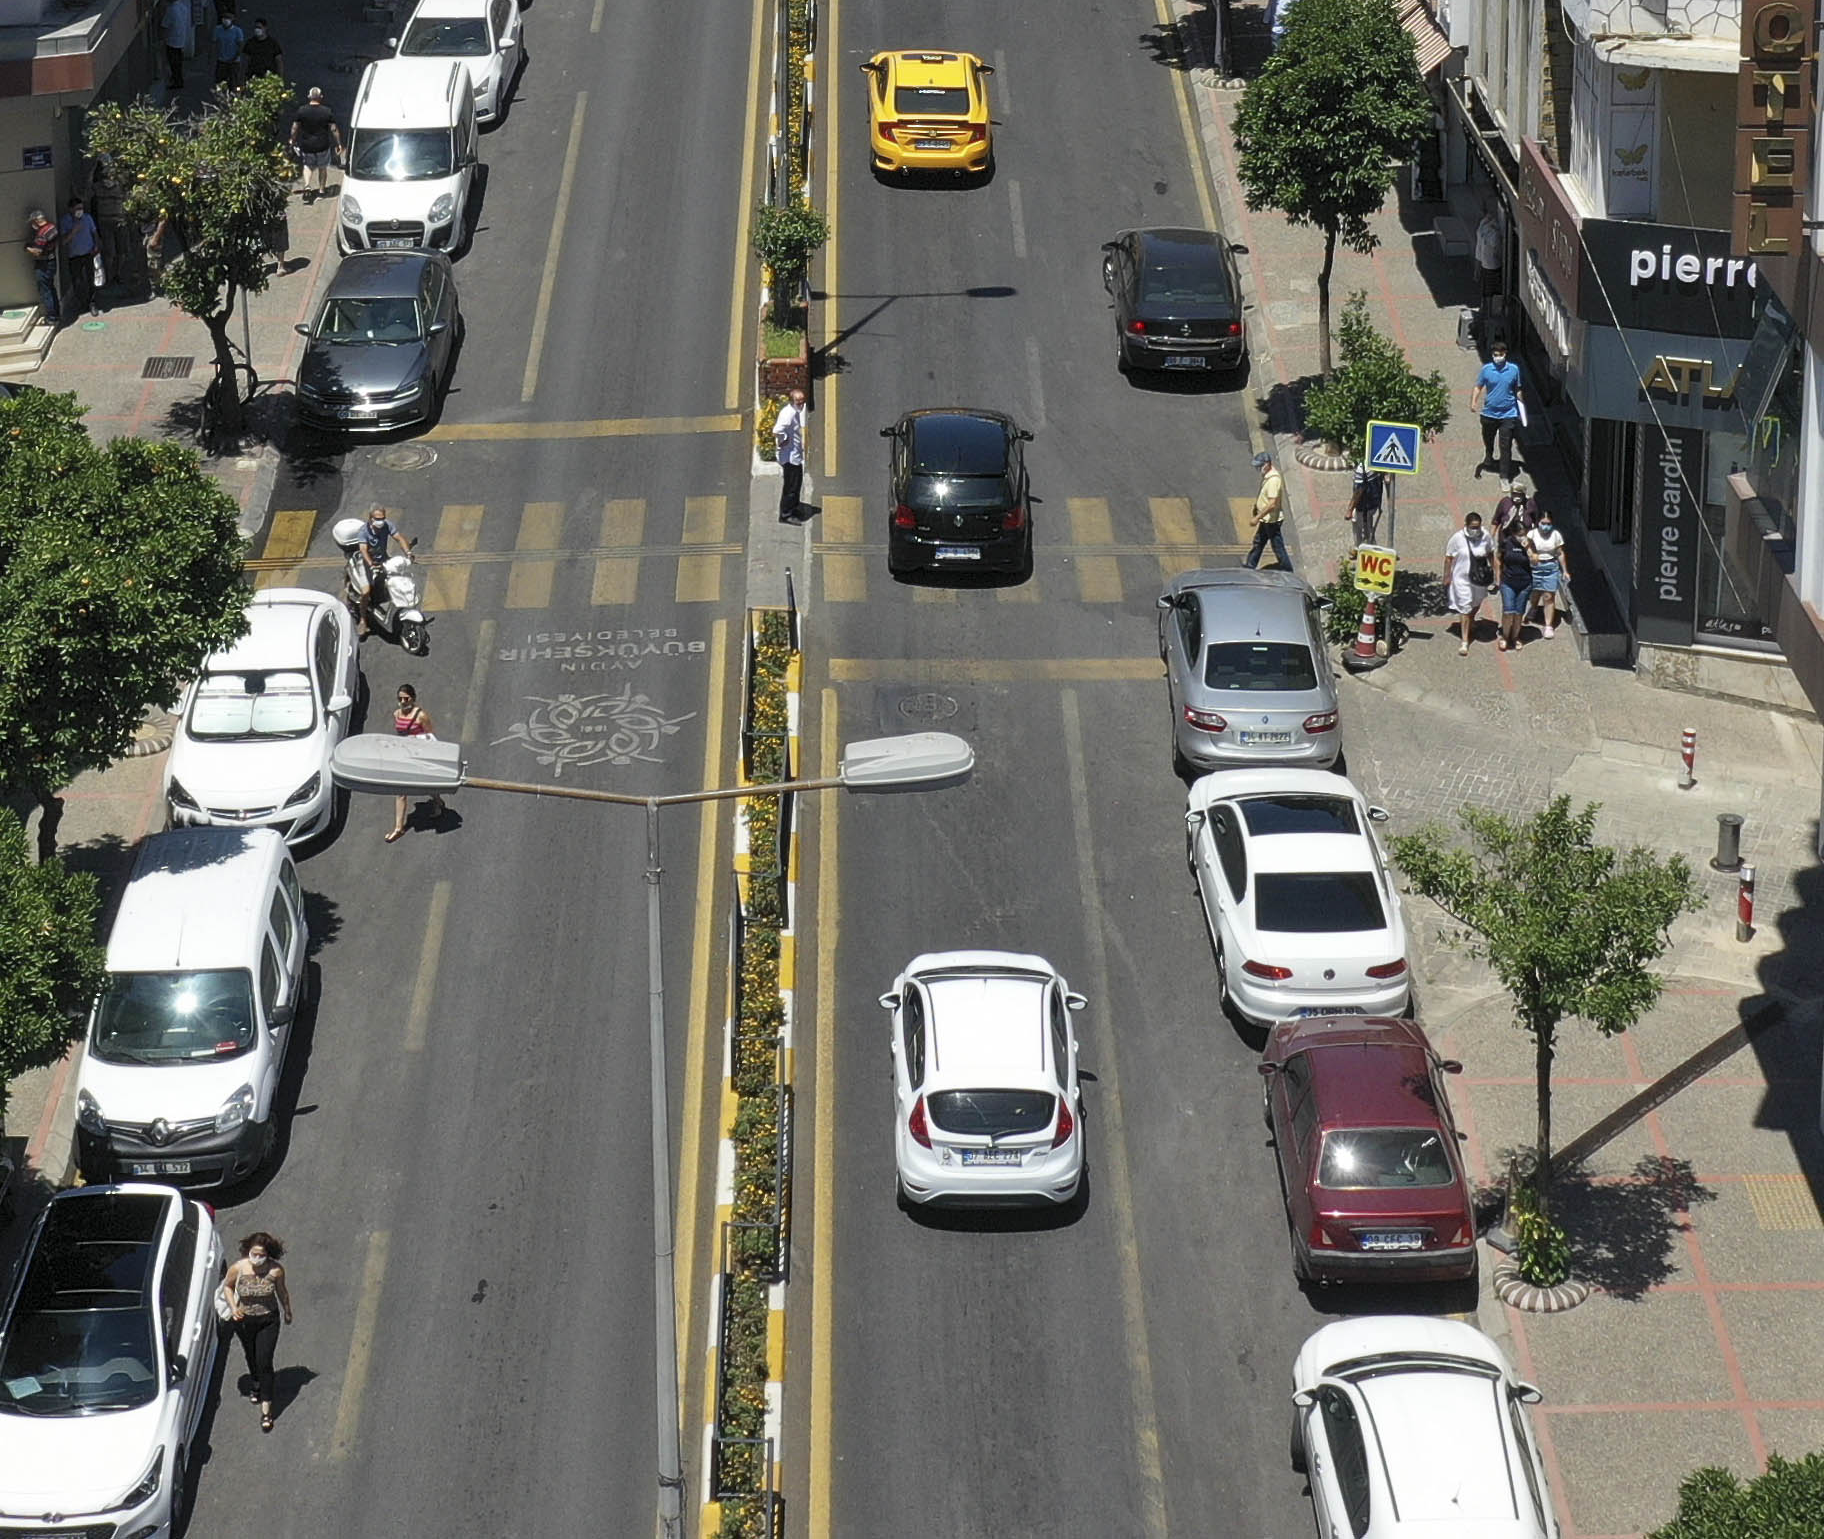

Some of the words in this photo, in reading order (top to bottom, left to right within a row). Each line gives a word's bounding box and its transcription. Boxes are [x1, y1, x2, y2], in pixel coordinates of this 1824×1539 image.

[1749, 2, 1806, 252] OTEL
[1643, 354, 1743, 399] ATL
[1659, 437, 1683, 519] cardin
[1361, 553, 1392, 577] WC
[1655, 524, 1683, 602] pierre
[560, 660, 643, 672] AYDIN
